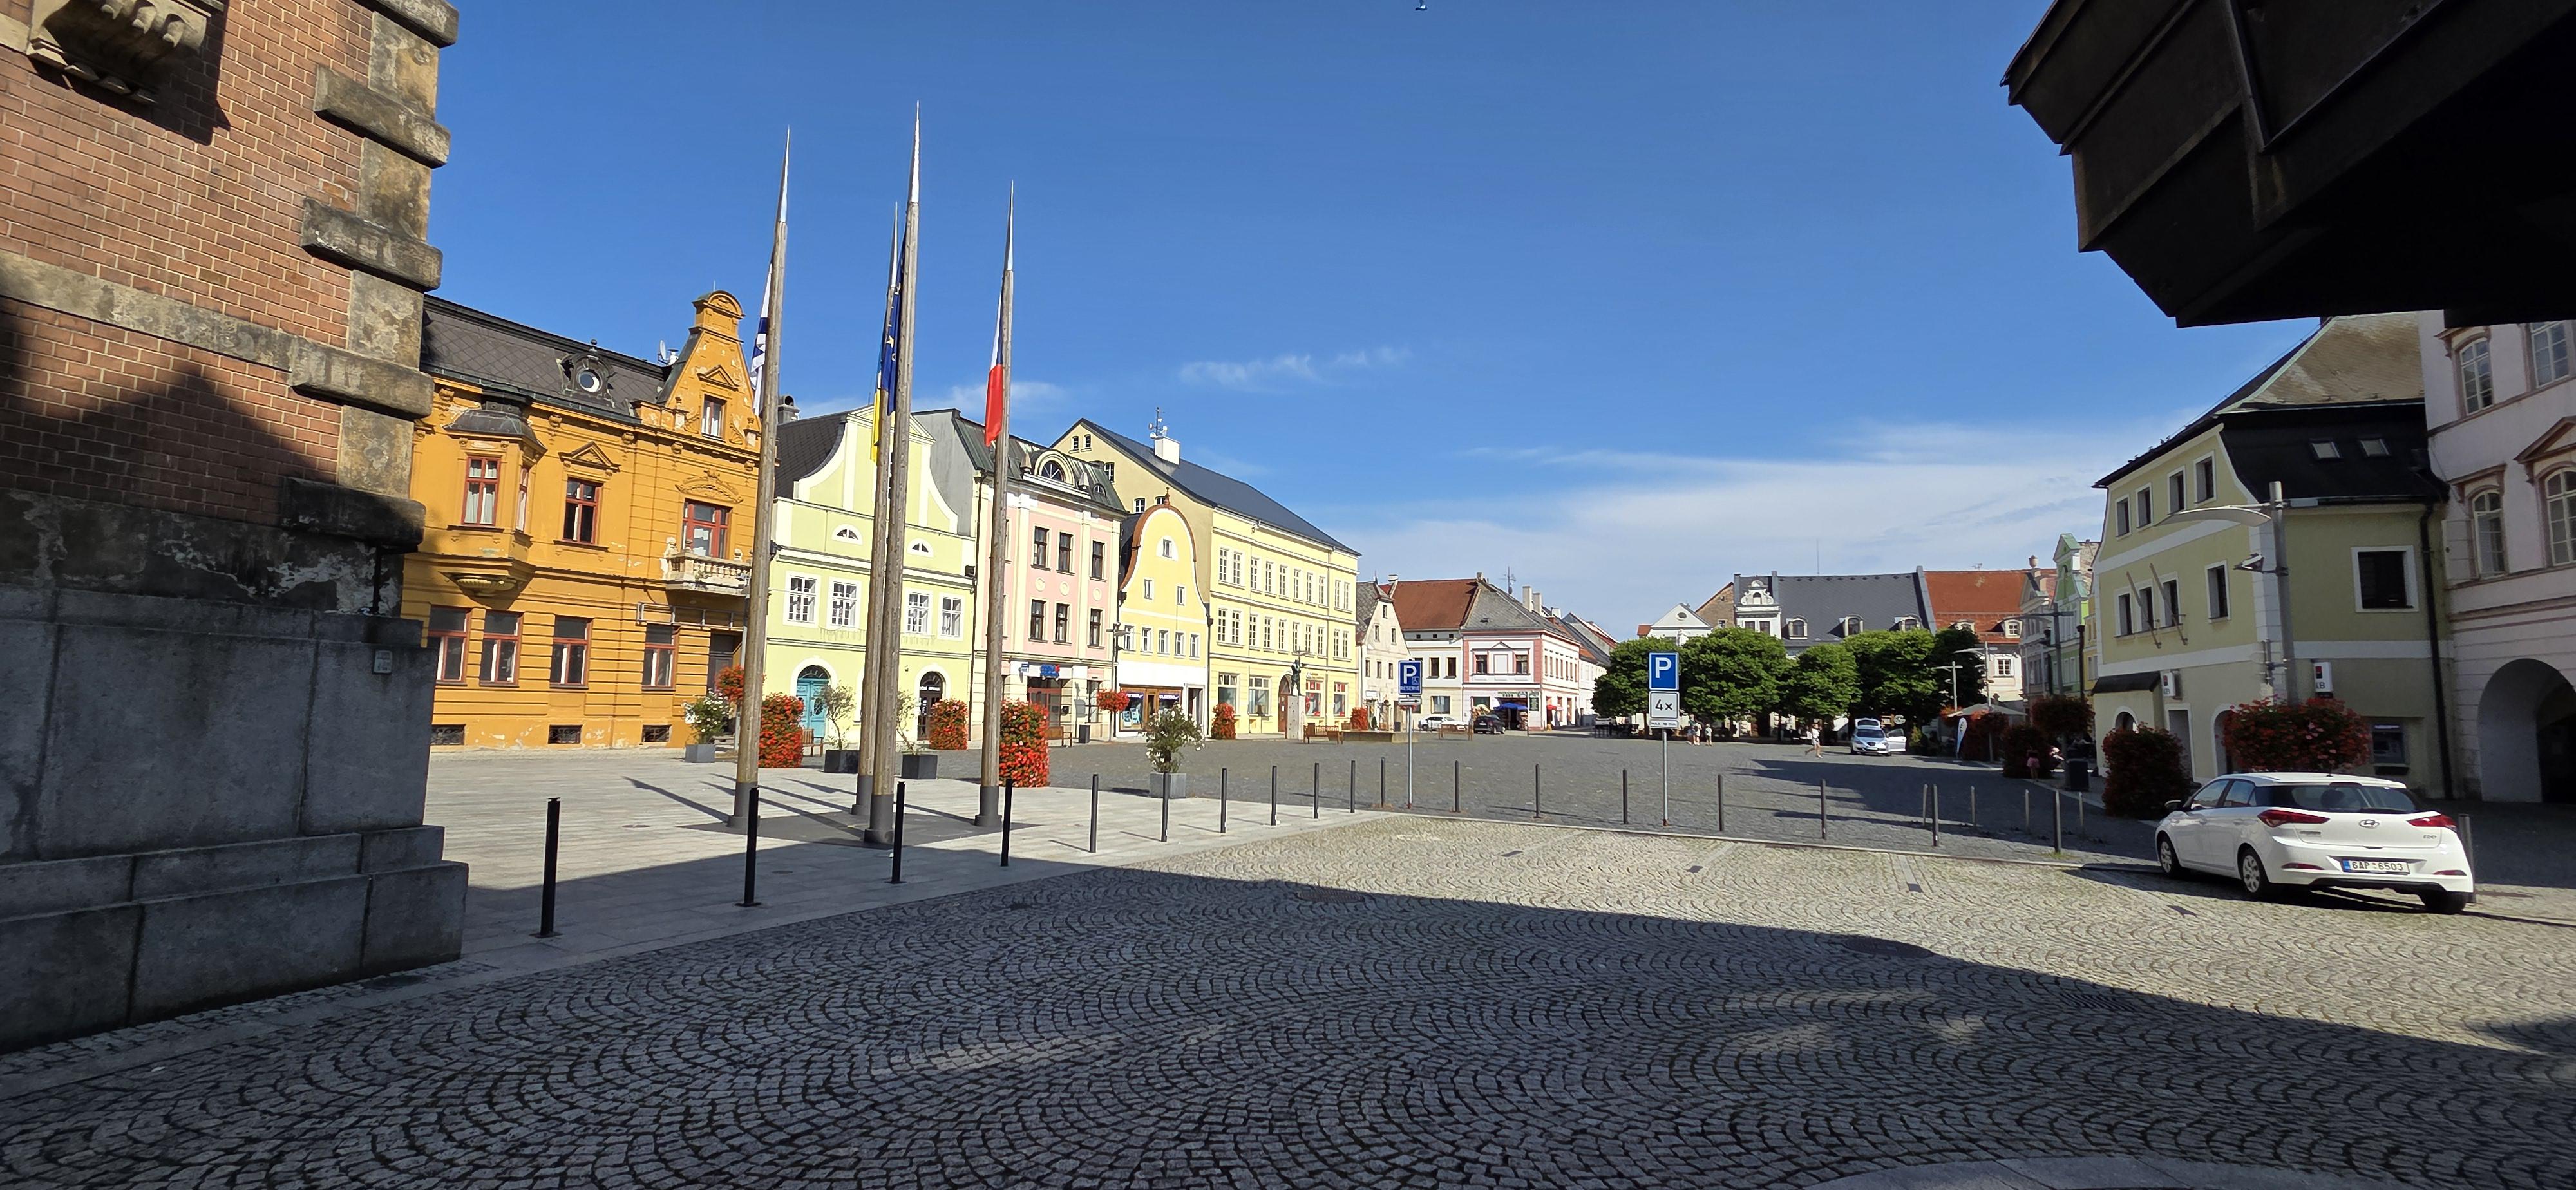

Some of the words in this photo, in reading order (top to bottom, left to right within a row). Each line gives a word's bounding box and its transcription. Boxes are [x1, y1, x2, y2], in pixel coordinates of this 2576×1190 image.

[1403, 665, 1417, 684] P
[1655, 657, 1672, 679] P
[2378, 862, 2403, 871] 6503
